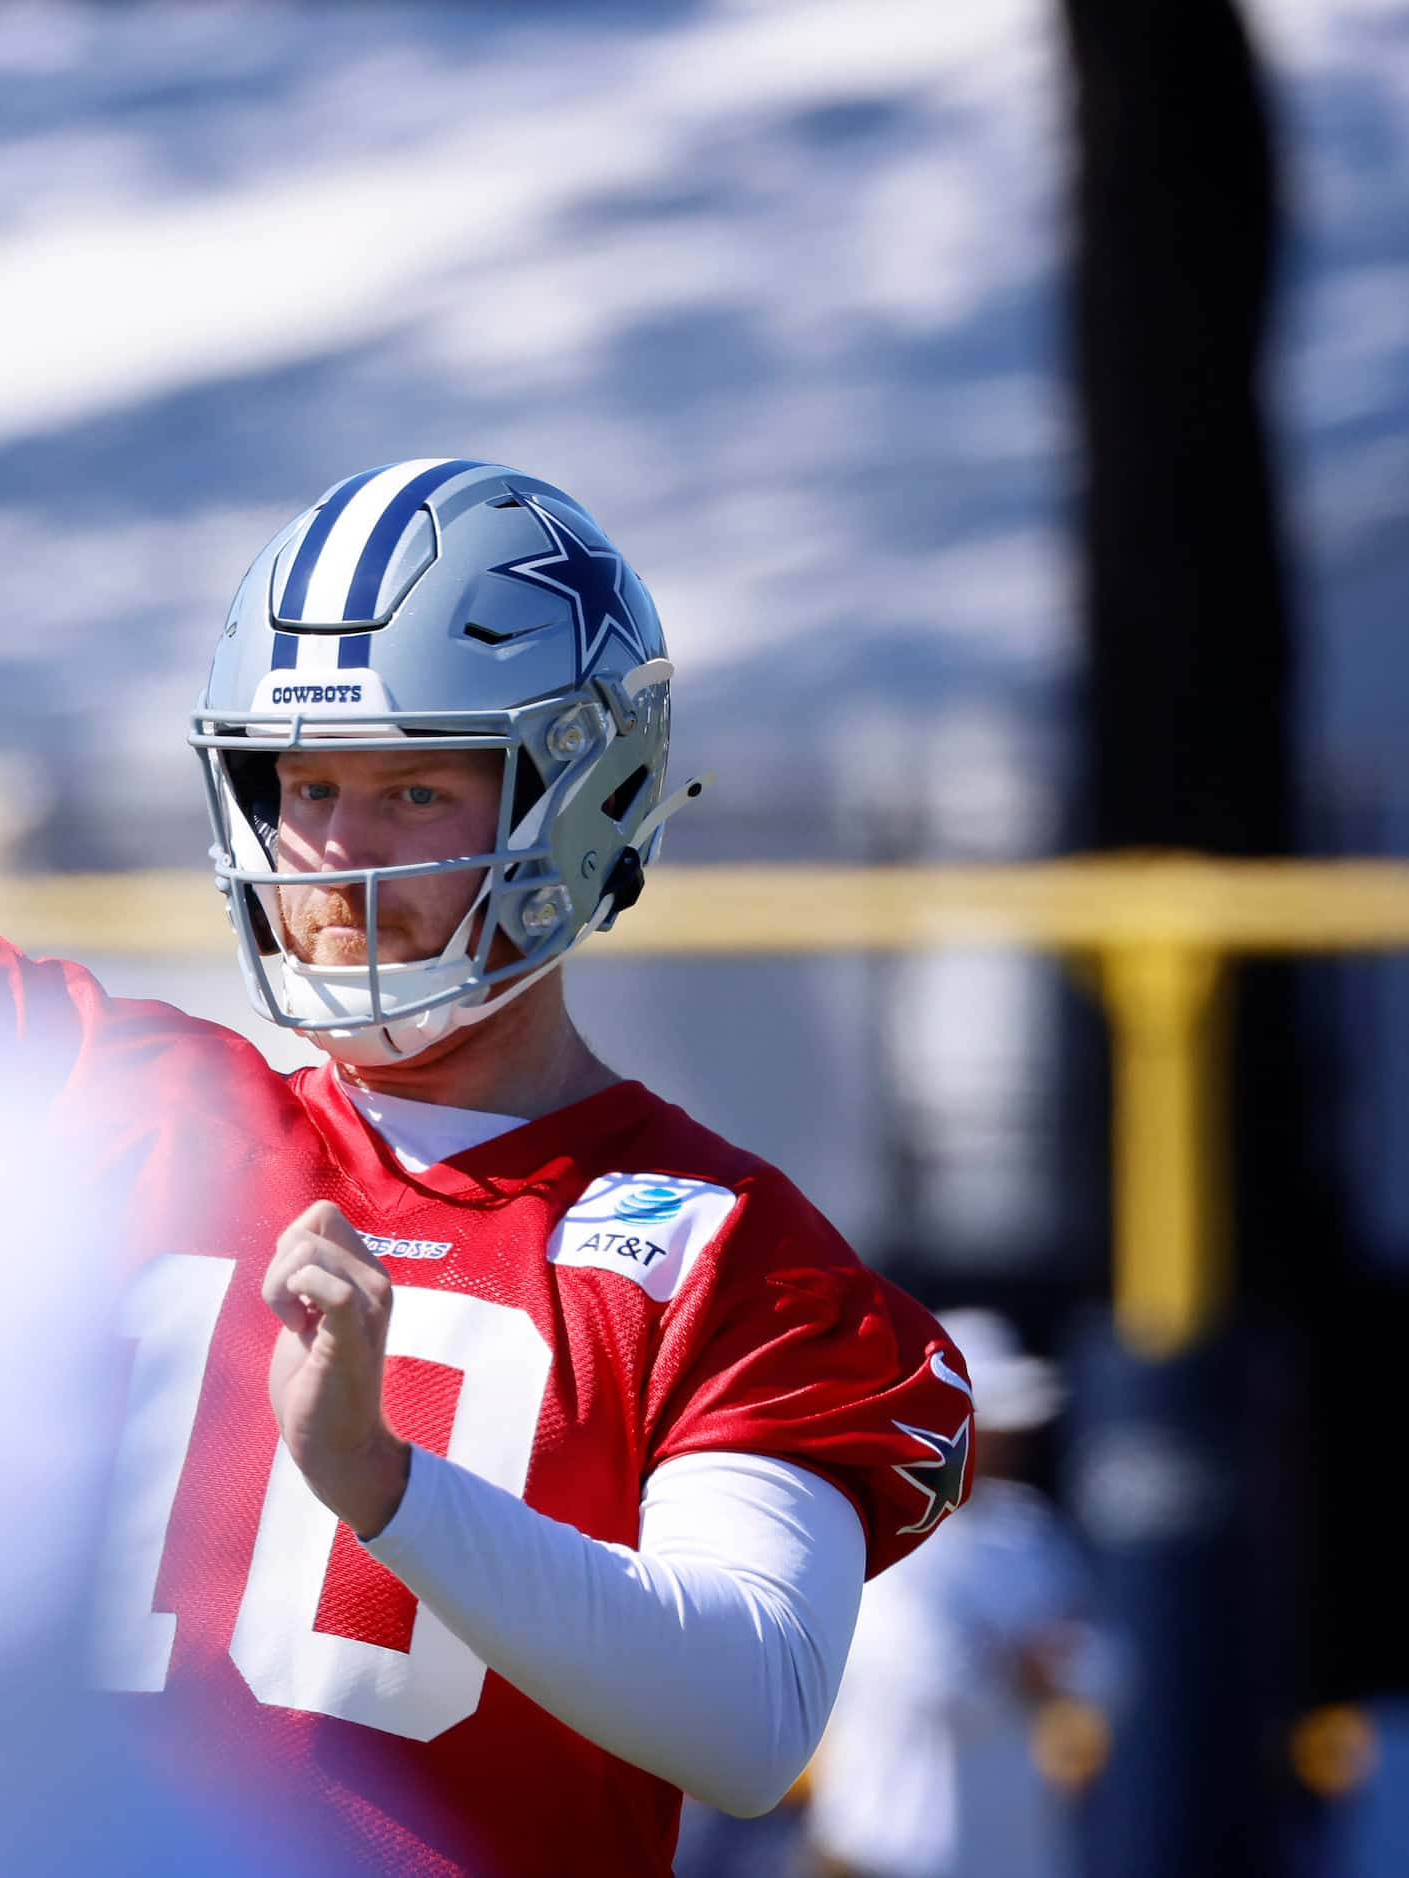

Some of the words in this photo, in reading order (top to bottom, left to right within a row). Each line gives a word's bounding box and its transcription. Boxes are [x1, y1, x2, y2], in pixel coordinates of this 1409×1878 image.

[272, 685, 362, 704] COWBOYS
[359, 1232, 452, 1259] BOYS
[577, 1233, 667, 1266] AT&T
[94, 1252, 553, 1743] 10
